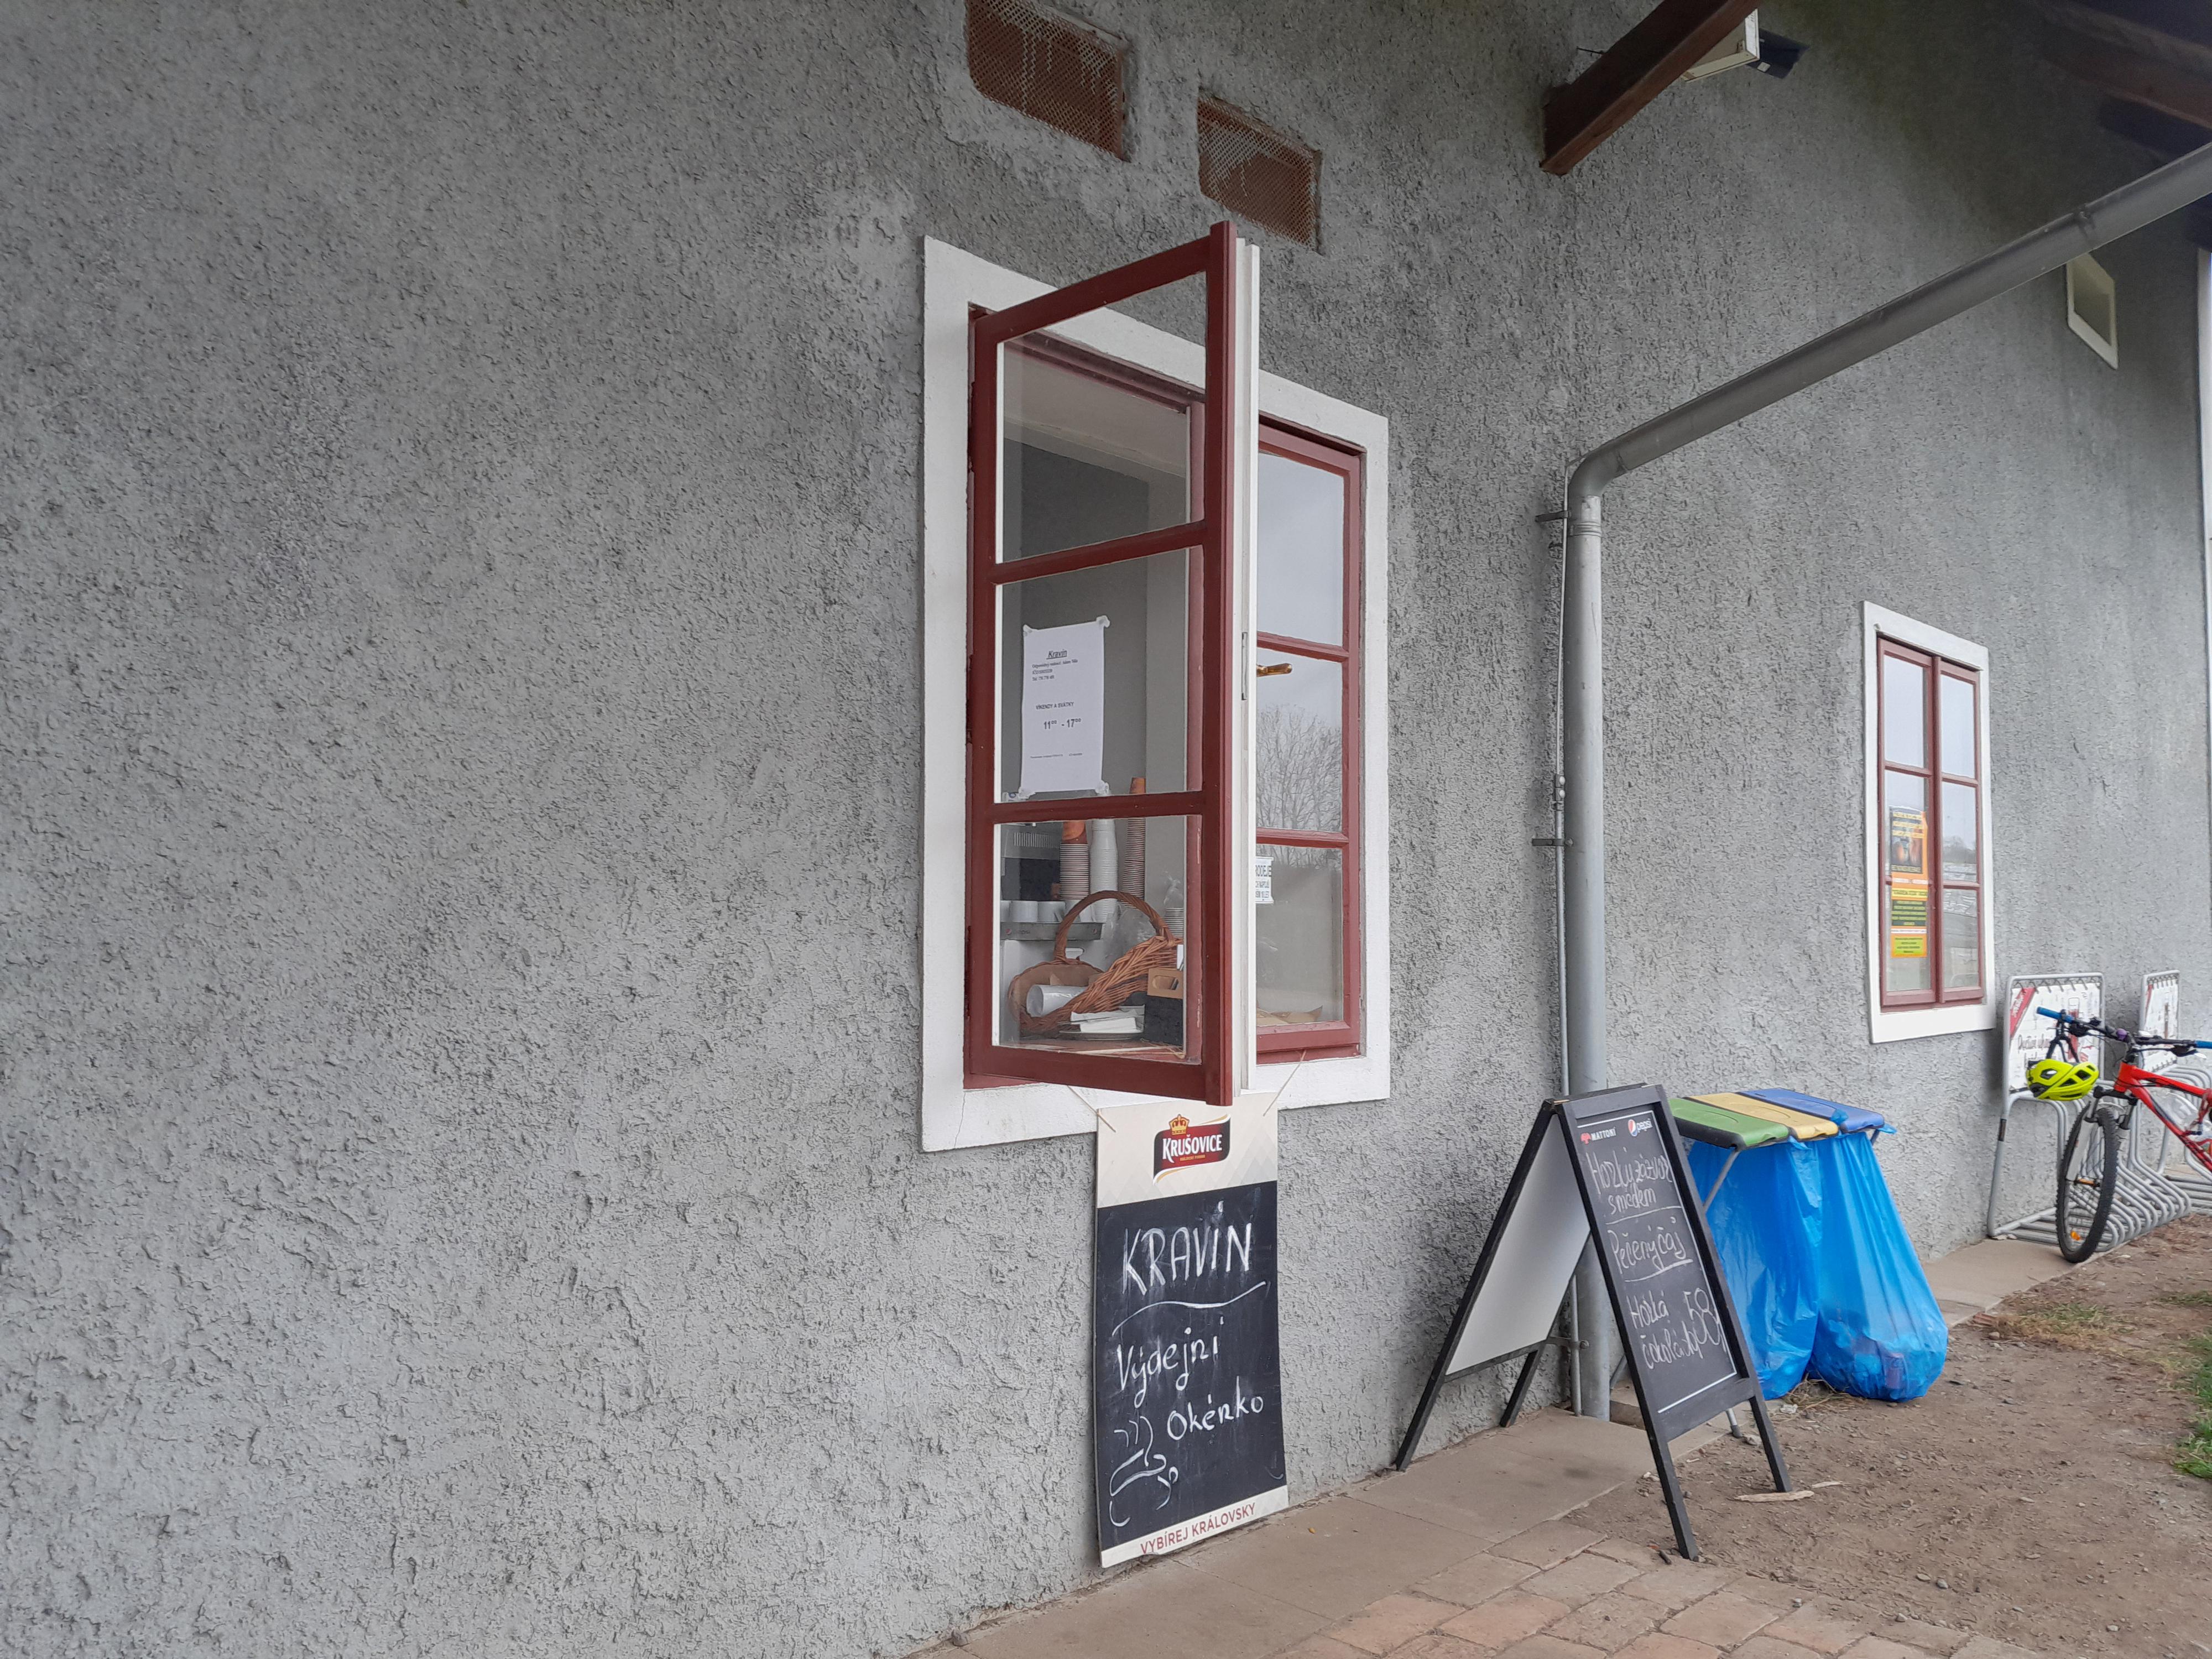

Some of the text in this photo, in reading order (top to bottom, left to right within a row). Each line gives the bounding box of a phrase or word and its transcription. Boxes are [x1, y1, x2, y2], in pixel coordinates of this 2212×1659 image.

[1591, 1128, 1616, 1141] MATTONI
[1636, 1118, 1653, 1133] pepsi
[1162, 1134, 1222, 1164] KRUŠOVICE
[1167, 1375, 1264, 1441] Okénko
[1140, 1502, 1256, 1554] VYBÍREJ KRÁLOVSKY
